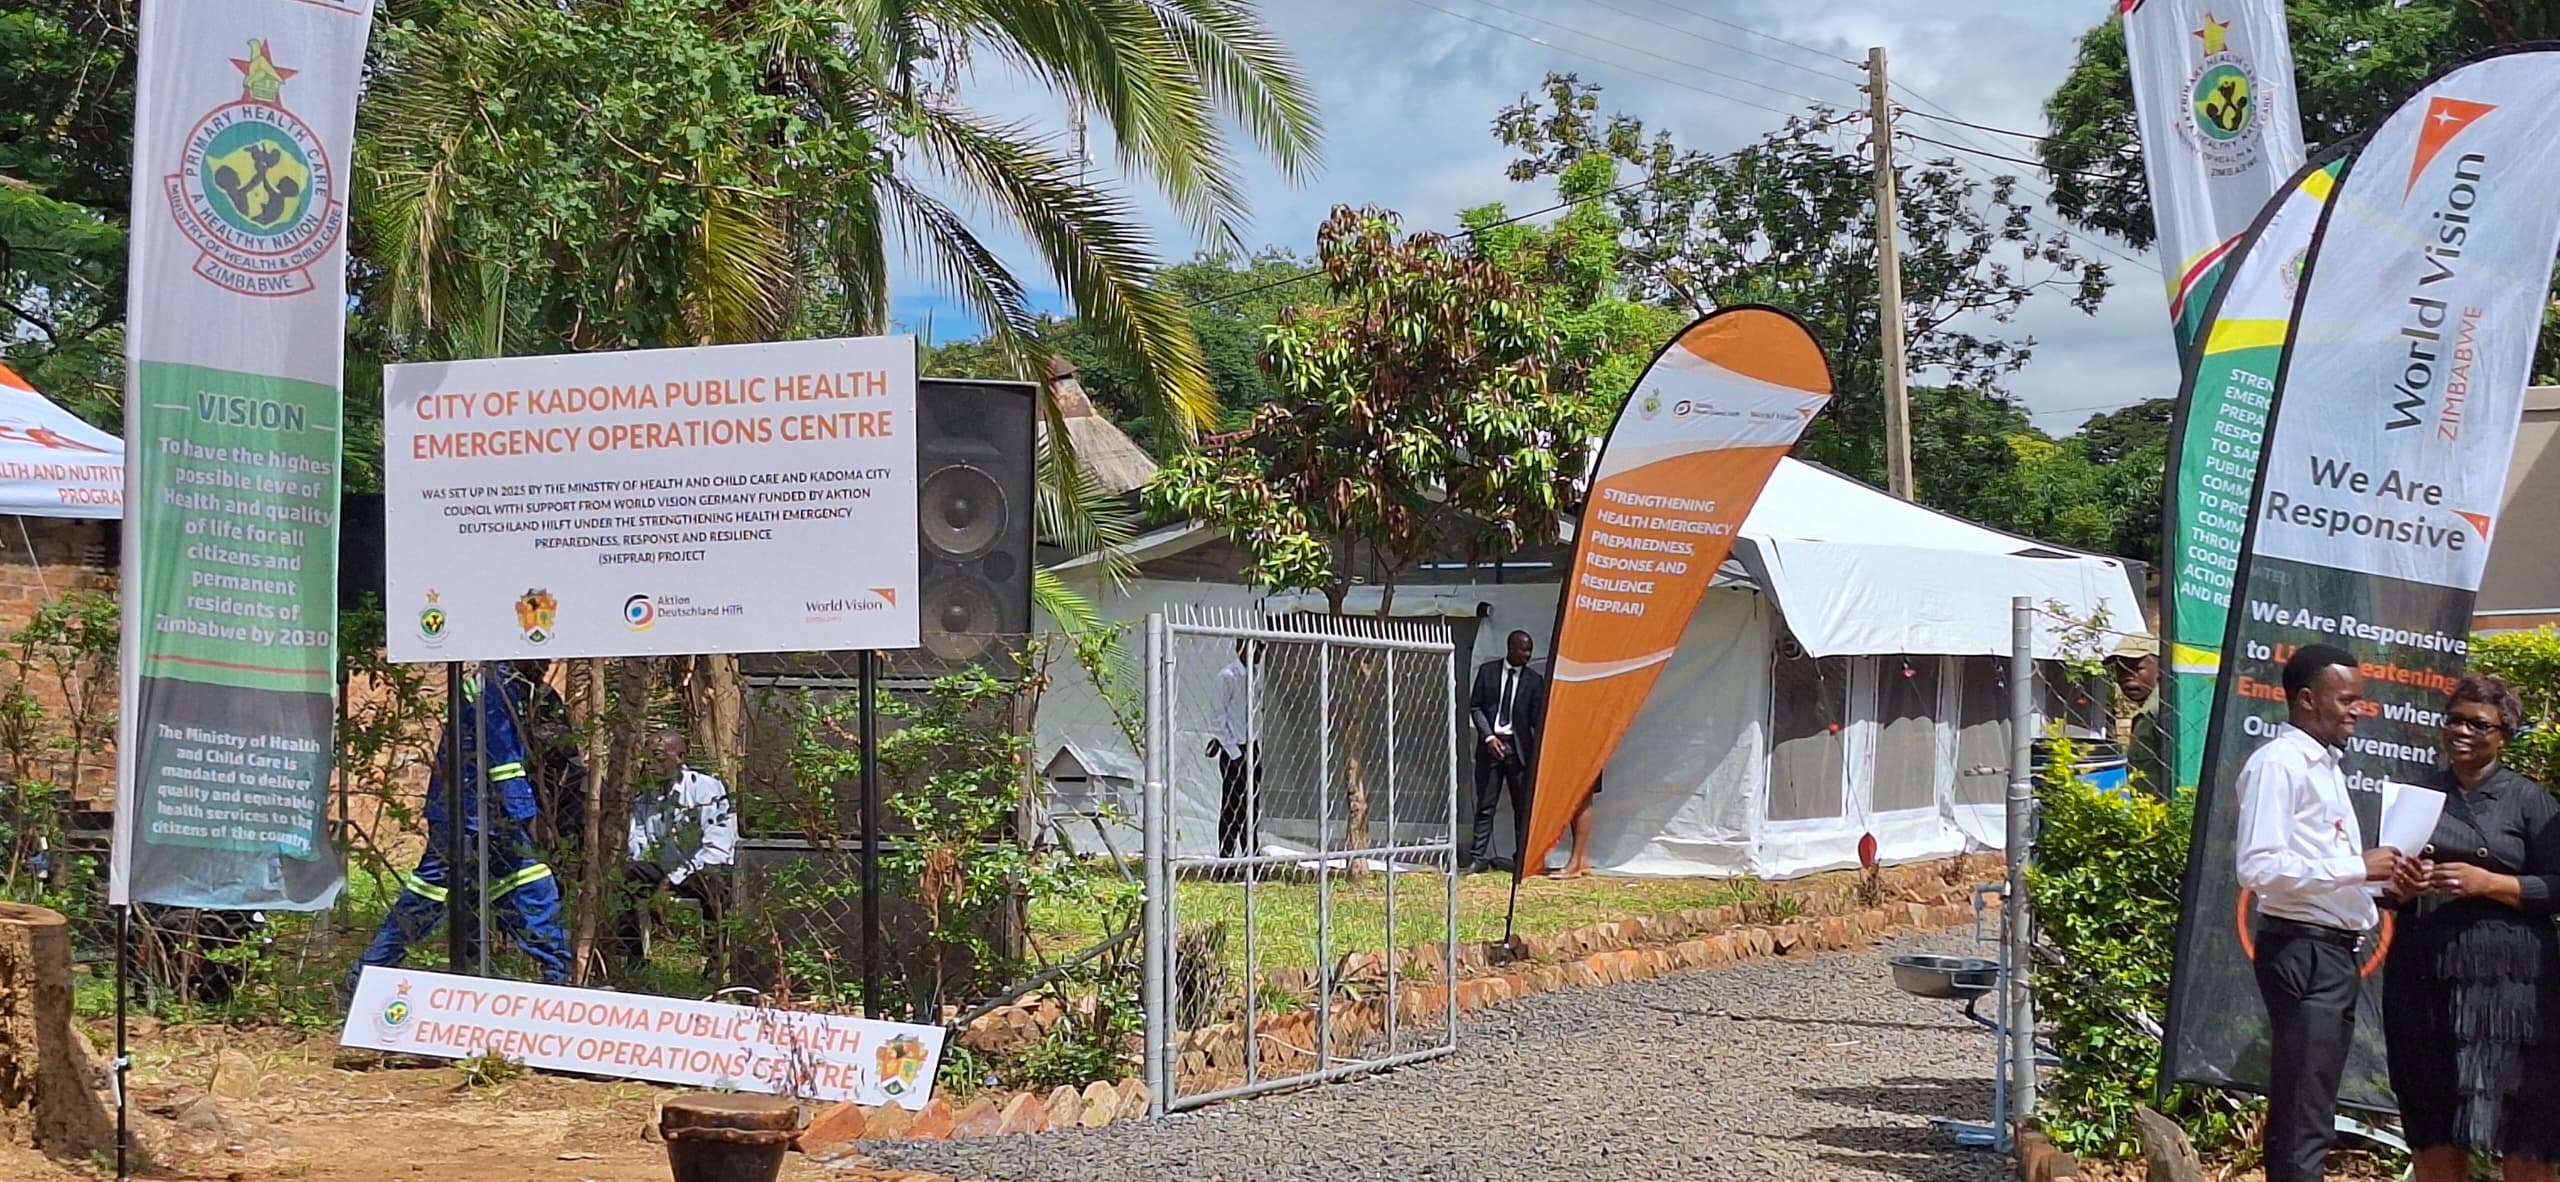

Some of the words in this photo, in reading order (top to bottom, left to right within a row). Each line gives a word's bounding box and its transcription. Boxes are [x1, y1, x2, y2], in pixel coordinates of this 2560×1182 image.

[186, 112, 233, 177] PRIMARY
[242, 106, 307, 142] HEALTH
[307, 148, 327, 198] CARE
[172, 184, 207, 240] MINISTRY
[205, 239, 223, 257] OF
[225, 251, 276, 270] HEALTH
[280, 257, 288, 266] &
[291, 240, 323, 265] CHILD
[322, 208, 342, 240] CARE
[191, 194, 204, 204] A
[200, 208, 265, 249] HEALTHY
[273, 213, 319, 249] NATION
[205, 261, 293, 291] ZIMBABWE
[2384, 297, 2448, 432] World
[2419, 152, 2485, 286] Vision
[2437, 305, 2483, 442] ZIMBABWE
[416, 393, 477, 420] CITY
[483, 390, 520, 417] OF
[527, 384, 658, 414] KADOMA
[665, 377, 766, 408] PUBLIC
[774, 371, 886, 401] HEALTH
[199, 391, 305, 432] VISION
[413, 427, 581, 460] EMERGENCY
[588, 418, 772, 451] OPERATIONS
[780, 411, 892, 442] CENTRE
[2211, 437, 2230, 454] TO
[2214, 420, 2261, 445] RESPO
[159, 437, 180, 455] To
[184, 439, 227, 461] have
[233, 448, 263, 466] the
[269, 450, 332, 475] highes
[0, 462, 30, 480] LTH
[34, 464, 66, 480] AND
[69, 465, 125, 483] NUTRIT
[176, 467, 250, 489] possible
[257, 475, 297, 494] leve
[302, 482, 321, 498] of
[422, 488, 447, 500] WAS
[449, 487, 467, 498] SET
[470, 487, 485, 498] UP
[487, 487, 498, 497] IN
[501, 485, 526, 496] 2025
[529, 485, 543, 496] BY
[545, 484, 565, 495] THE
[568, 481, 620, 493] MINISTRY
[623, 480, 637, 491] OF
[640, 477, 683, 490] HEALTH
[686, 477, 710, 489] AND
[713, 475, 747, 487] CHILD
[750, 473, 779, 485] CARE
[782, 472, 807, 484] AND
[810, 470, 863, 482] KADOMA
[865, 468, 891, 480] CITY
[2310, 455, 2369, 494] We
[2376, 469, 2443, 506] Are
[164, 488, 220, 510] Health
[225, 500, 260, 516] and
[266, 505, 332, 528] quality
[444, 505, 491, 517] COUNCIL
[494, 503, 524, 515] WITH
[527, 501, 576, 513] SUPPORT
[579, 500, 611, 511] FROM
[614, 498, 655, 510] WORLD
[658, 495, 697, 507] VISION
[700, 493, 755, 506] GERMANY
[759, 491, 806, 504] FUNDED
[809, 490, 824, 501] BY
[826, 488, 871, 500] AKTION
[1603, 488, 1715, 513] STRENGTHENING
[2199, 490, 2218, 507] TO
[186, 518, 208, 534] of
[211, 520, 242, 539] life
[246, 526, 276, 543] for
[280, 530, 304, 547] all
[459, 521, 539, 534] DEUTSCHLAND
[542, 520, 572, 532] HILFT
[574, 518, 612, 530] UNDER
[616, 517, 635, 528] THE
[639, 512, 733, 527] STRENGTHENING
[736, 510, 780, 523] HEALTH
[783, 508, 852, 522] EMERGENCY
[1597, 509, 1648, 529] HEALTH
[1650, 517, 1733, 536] EMERGENCY
[2265, 490, 2465, 551] Responsive
[623, 533, 680, 546] RESPONSE
[682, 531, 707, 544] AND
[710, 529, 772, 542] RESILIENCE
[1592, 530, 1695, 556] PREPAREDNESS,
[2192, 526, 2241, 553] THROU
[187, 544, 261, 567] citizens
[265, 555, 301, 571] and
[599, 553, 655, 566] (SHEPRAR)
[658, 550, 706, 563] PROJECT
[1586, 552, 1653, 573] RESPONSE
[1655, 562, 1687, 575] AND
[2188, 545, 2238, 572] COORD
[192, 571, 296, 596] permanent
[1581, 574, 1655, 594] RESILIENCE
[2180, 582, 2210, 601] AND
[187, 594, 274, 618] residents
[279, 605, 300, 621] of
[658, 595, 690, 605] Aktion
[658, 606, 719, 618] Deutschland
[806, 599, 842, 613] World
[845, 598, 882, 611] Vision
[1575, 594, 1644, 617] (SHEPRAR)
[156, 614, 246, 641] Zimbabwe
[252, 626, 274, 646] by
[280, 629, 328, 646] 2030
[2251, 600, 2290, 625] We
[2292, 608, 2336, 633] Are
[2339, 615, 2467, 655] Responsive
[2246, 640, 2271, 661] to
[158, 724, 182, 739] The
[186, 728, 247, 749] Ministry
[250, 735, 266, 748] of
[270, 735, 320, 753] Health
[2243, 715, 2281, 739] Ou
[2345, 736, 2436, 765] vement
[177, 748, 203, 761] and
[206, 750, 244, 765] Child
[248, 753, 281, 768] Care
[162, 766, 235, 783] mandated
[240, 772, 255, 784] to
[259, 774, 310, 790] deliver
[158, 784, 209, 802] quality
[212, 789, 240, 803] and
[158, 801, 203, 818] health
[207, 809, 269, 823] services
[272, 814, 288, 824] to
[292, 814, 313, 831] the
[152, 820, 208, 838] citizens
[211, 825, 226, 838] of
[232, 827, 256, 841] the
[430, 988, 488, 1013] CITY
[491, 994, 528, 1017] OF
[531, 999, 650, 1032] KADOMA
[656, 1010, 752, 1042] PUBLIC
[756, 1022, 862, 1054] HEALTH
[416, 1021, 574, 1057] EMERGENCY
[577, 1038, 746, 1077] OPERATIONS
[752, 1056, 854, 1090] CETRE
